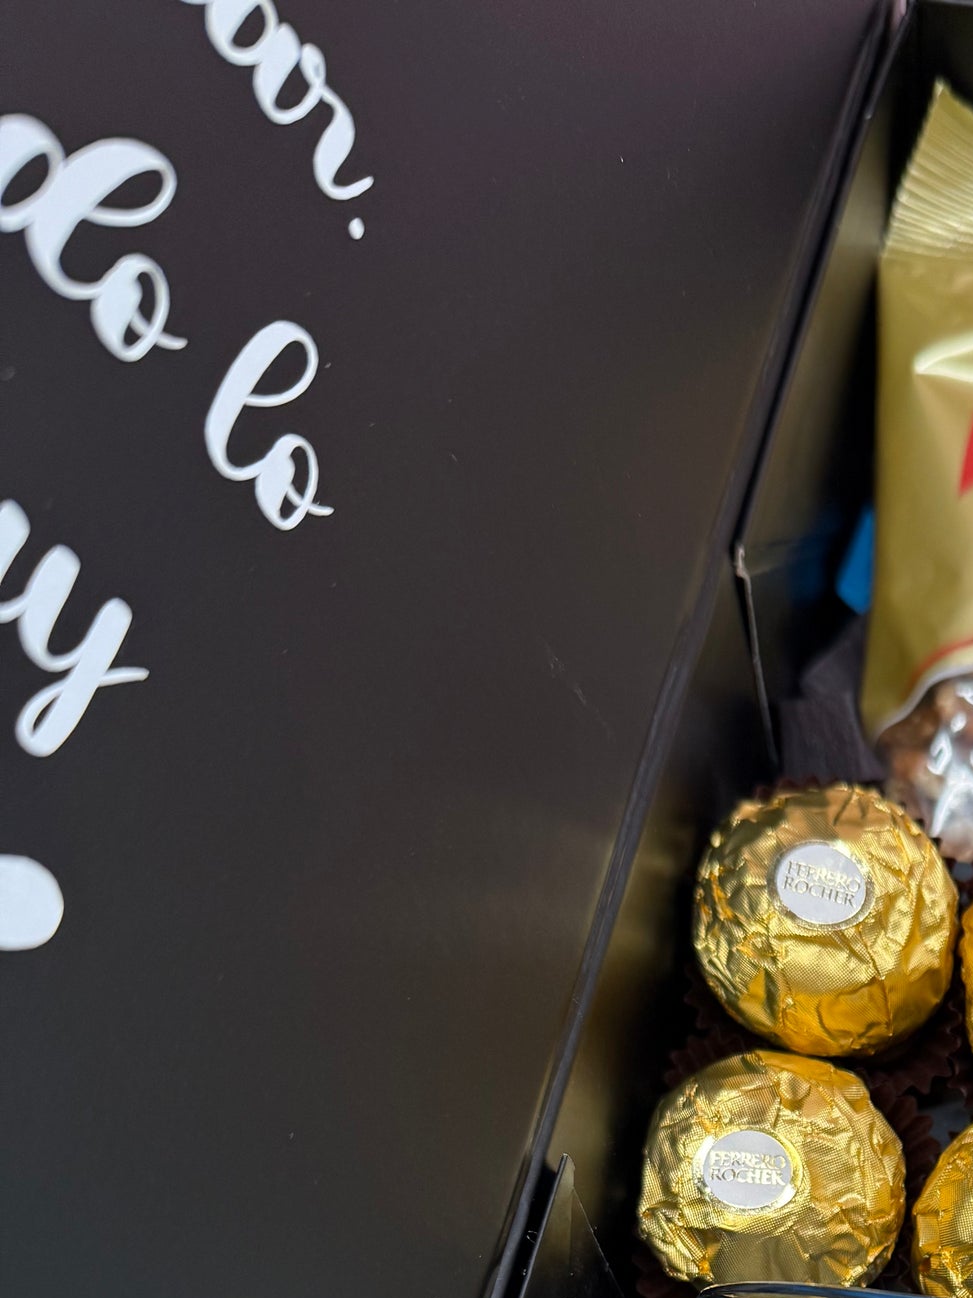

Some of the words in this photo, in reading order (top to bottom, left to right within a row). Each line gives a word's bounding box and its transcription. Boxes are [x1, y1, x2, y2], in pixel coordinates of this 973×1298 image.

[786, 861, 861, 893] FERRERO
[783, 876, 856, 908] ROCHER
[710, 1151, 786, 1170] FERRERO
[710, 1168, 785, 1186] ROCHER
